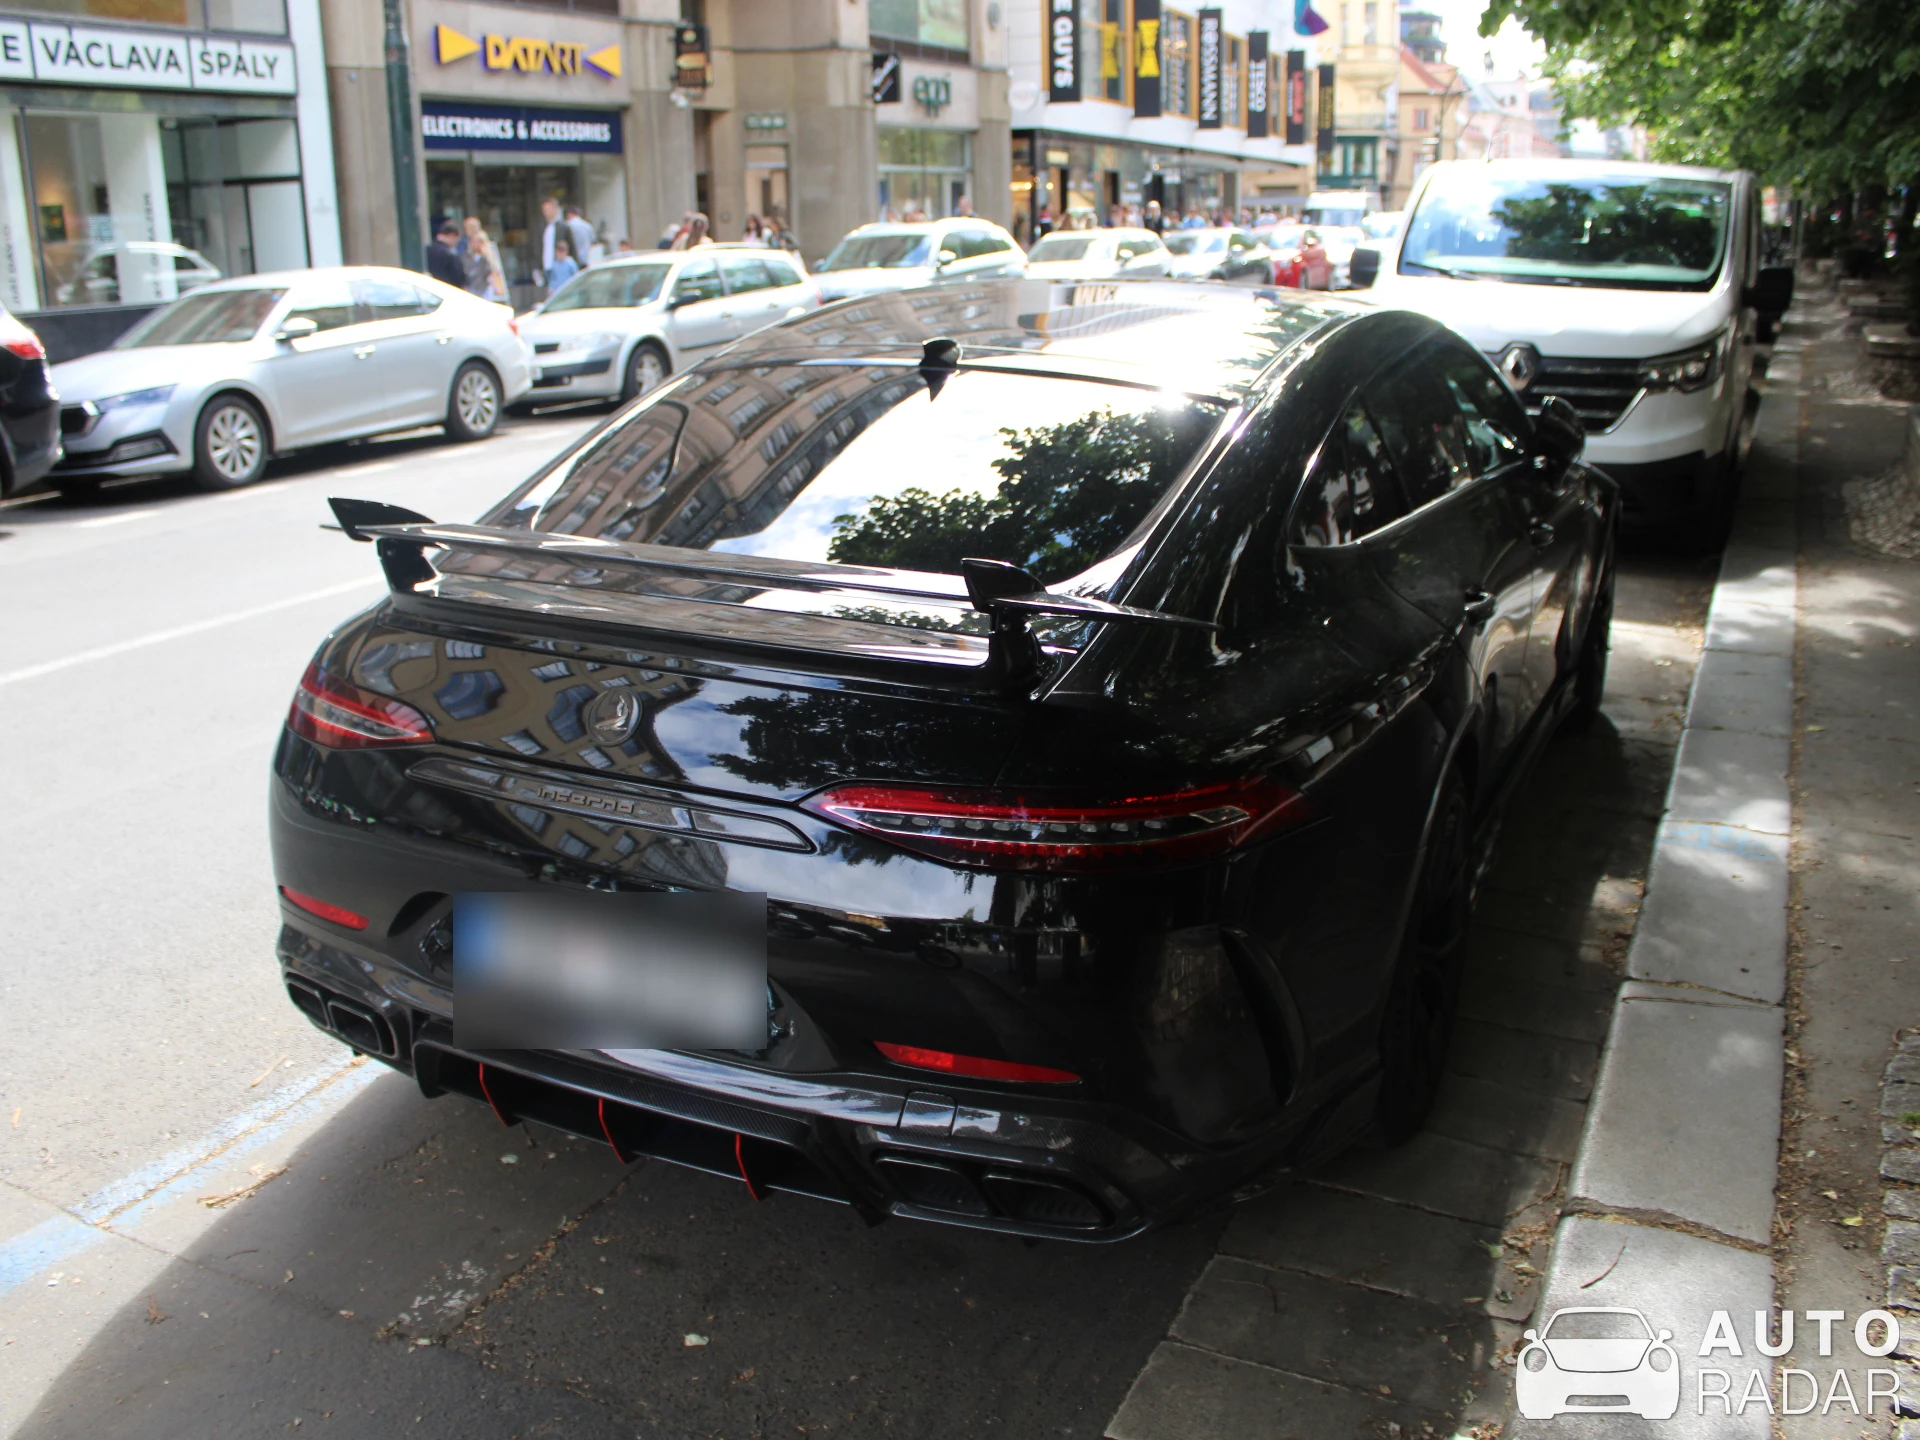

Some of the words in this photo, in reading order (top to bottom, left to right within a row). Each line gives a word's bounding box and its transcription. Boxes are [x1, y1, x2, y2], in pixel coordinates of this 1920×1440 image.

[483, 34, 587, 76] DATART
[1053, 16, 1074, 89] GUYS
[1201, 17, 1219, 120] ROSSMANN
[422, 115, 514, 139] ELECTRONICS
[517, 120, 529, 139] &
[530, 120, 611, 142] ACCESSORIES
